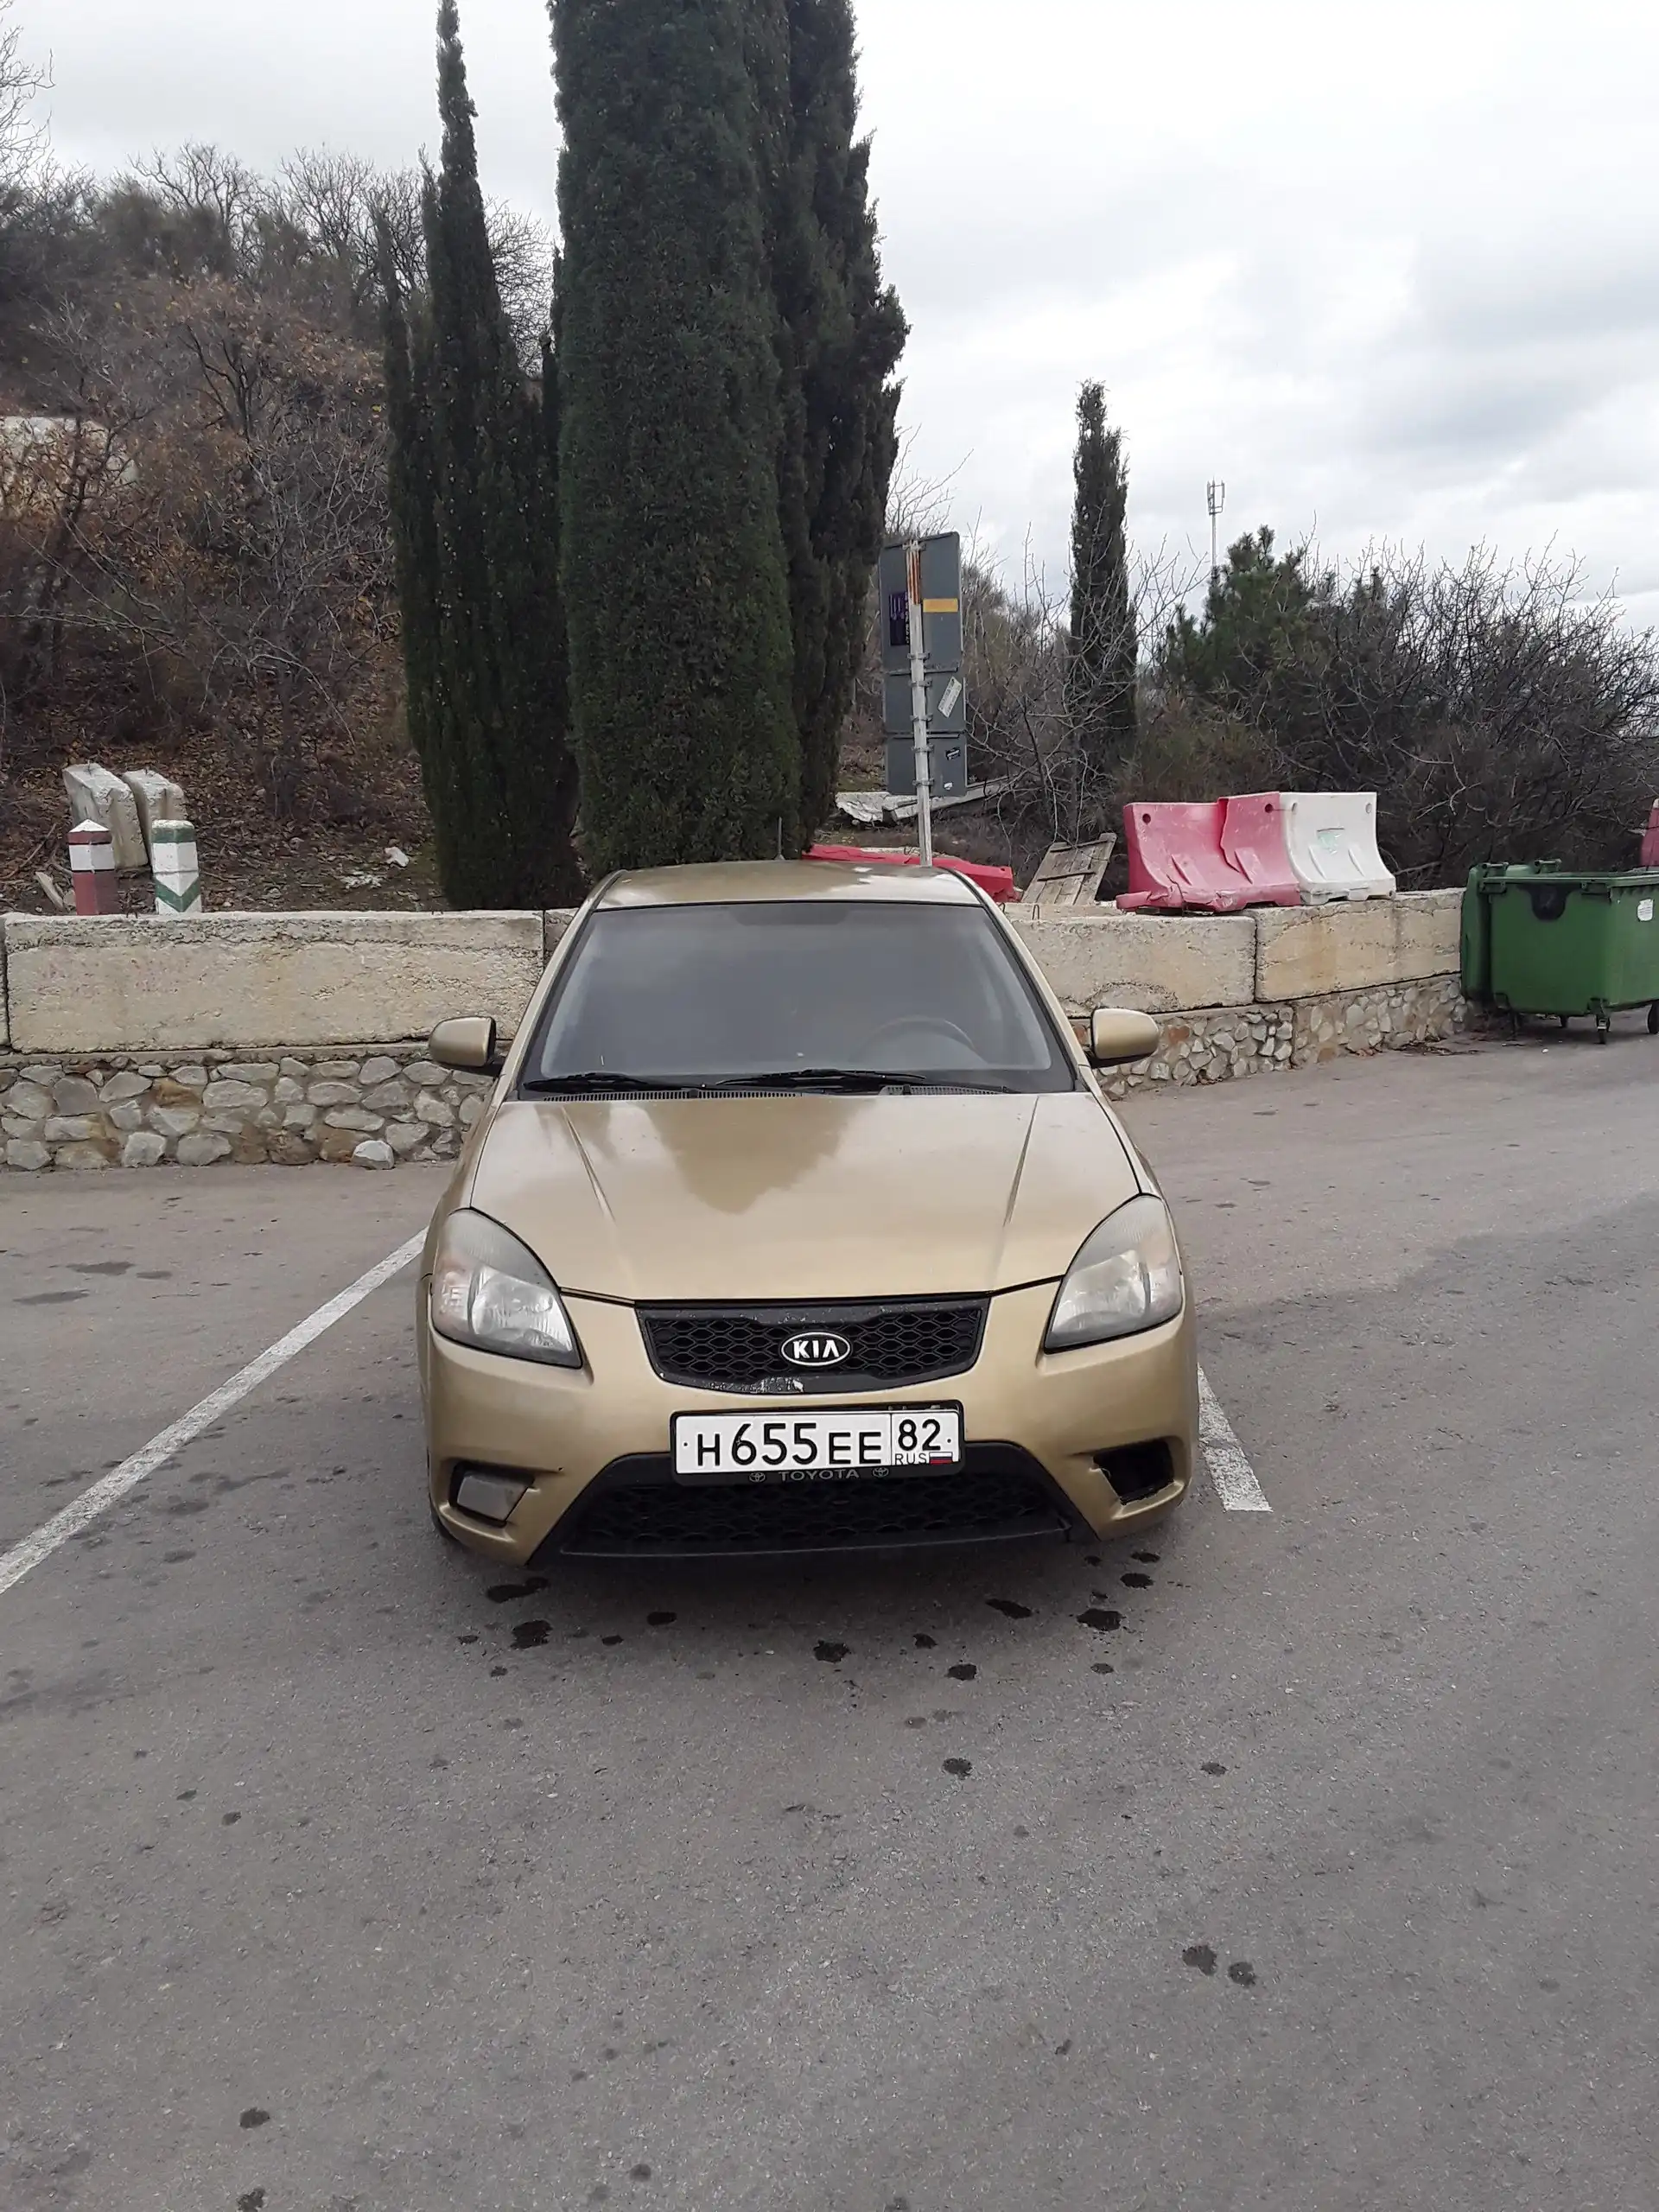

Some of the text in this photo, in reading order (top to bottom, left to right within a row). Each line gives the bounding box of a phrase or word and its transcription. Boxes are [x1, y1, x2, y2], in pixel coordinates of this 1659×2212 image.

[793, 1340, 840, 1358] KIA
[898, 1419, 942, 1451] 82
[895, 1452, 927, 1465] RUS
[779, 1468, 860, 1482] TOYOTA
